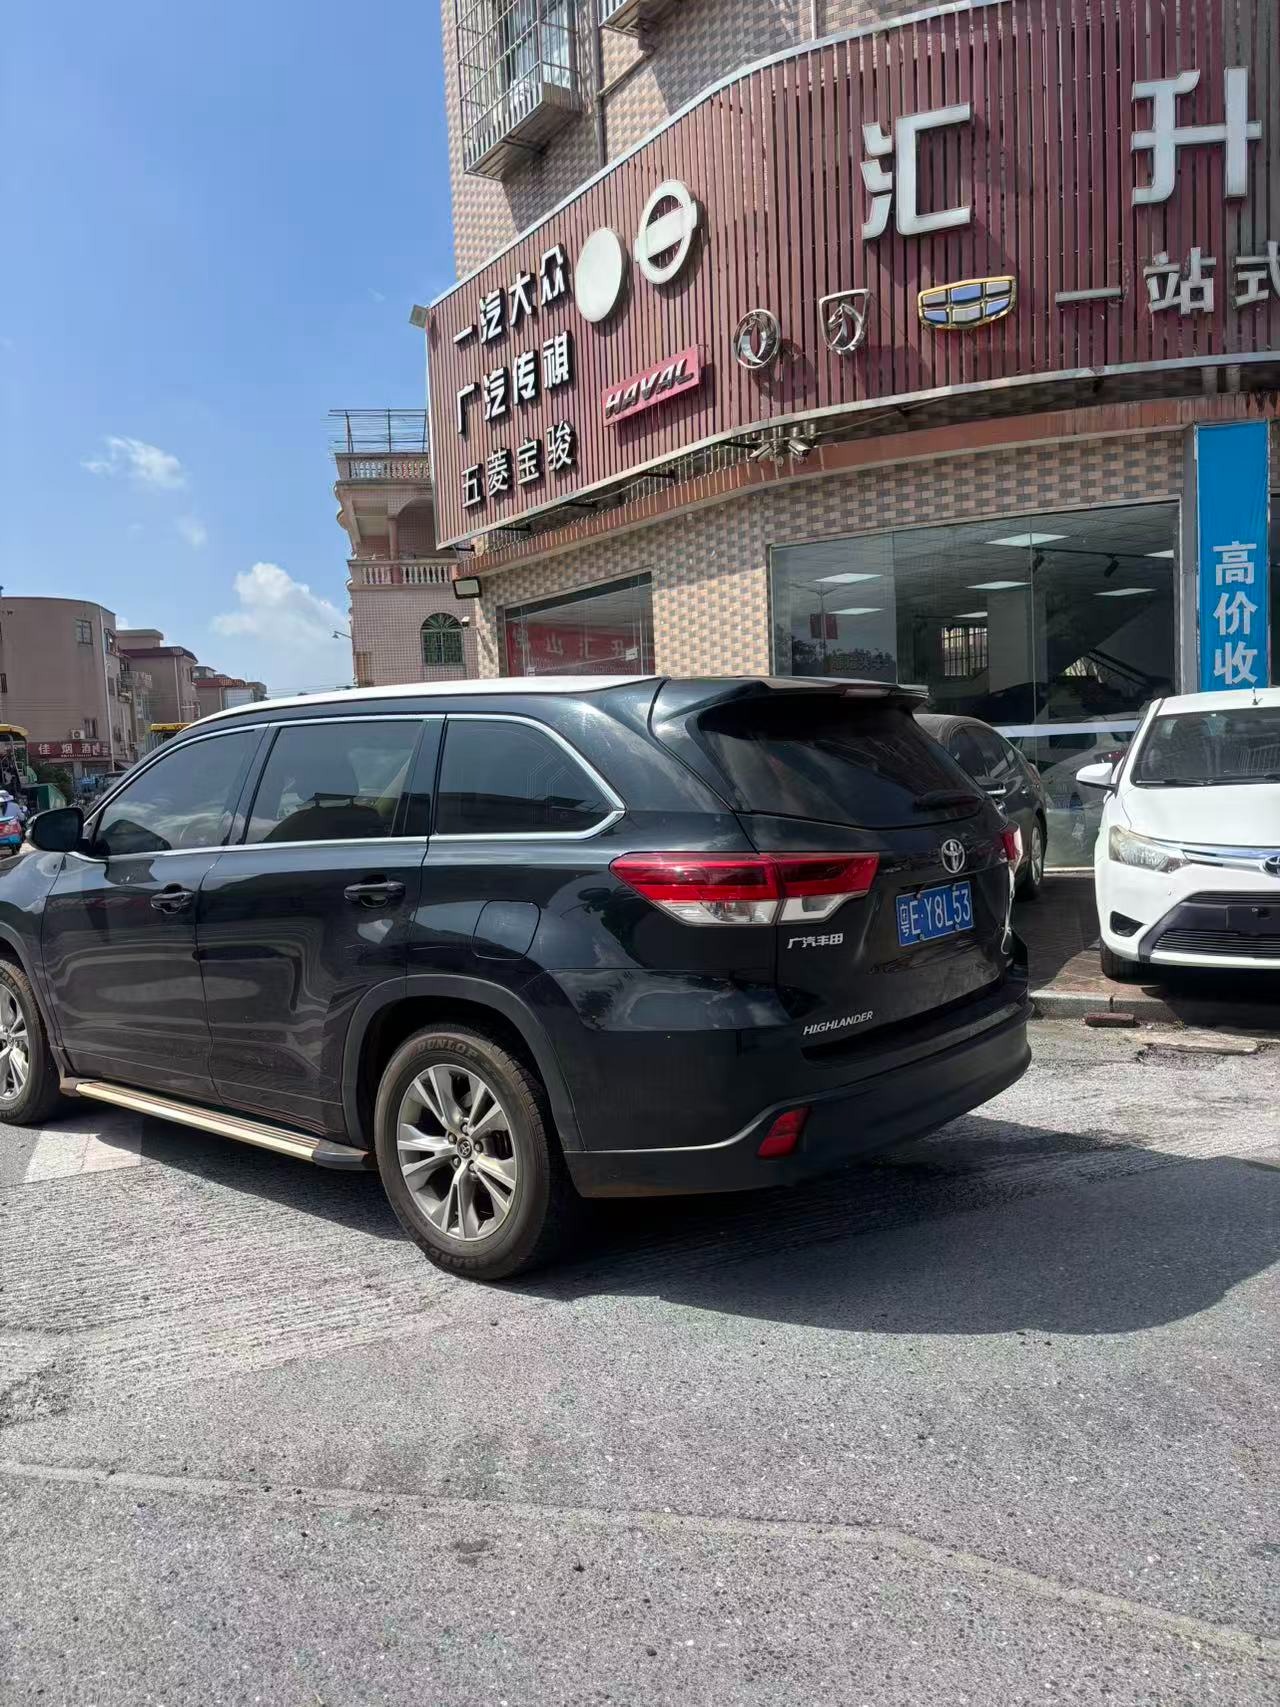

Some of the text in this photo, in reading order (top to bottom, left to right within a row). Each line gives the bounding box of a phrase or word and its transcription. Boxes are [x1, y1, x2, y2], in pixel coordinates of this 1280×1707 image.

[860, 66, 1262, 240] 汇升
[452, 243, 567, 345] 一汽大众
[605, 359, 694, 419] HAVAL
[461, 420, 576, 508] 五菱宝骏
[1212, 541, 1258, 685] 高价收
[787, 933, 844, 949] 广汽丰田
[803, 1010, 874, 1035] HIGHLANDER
